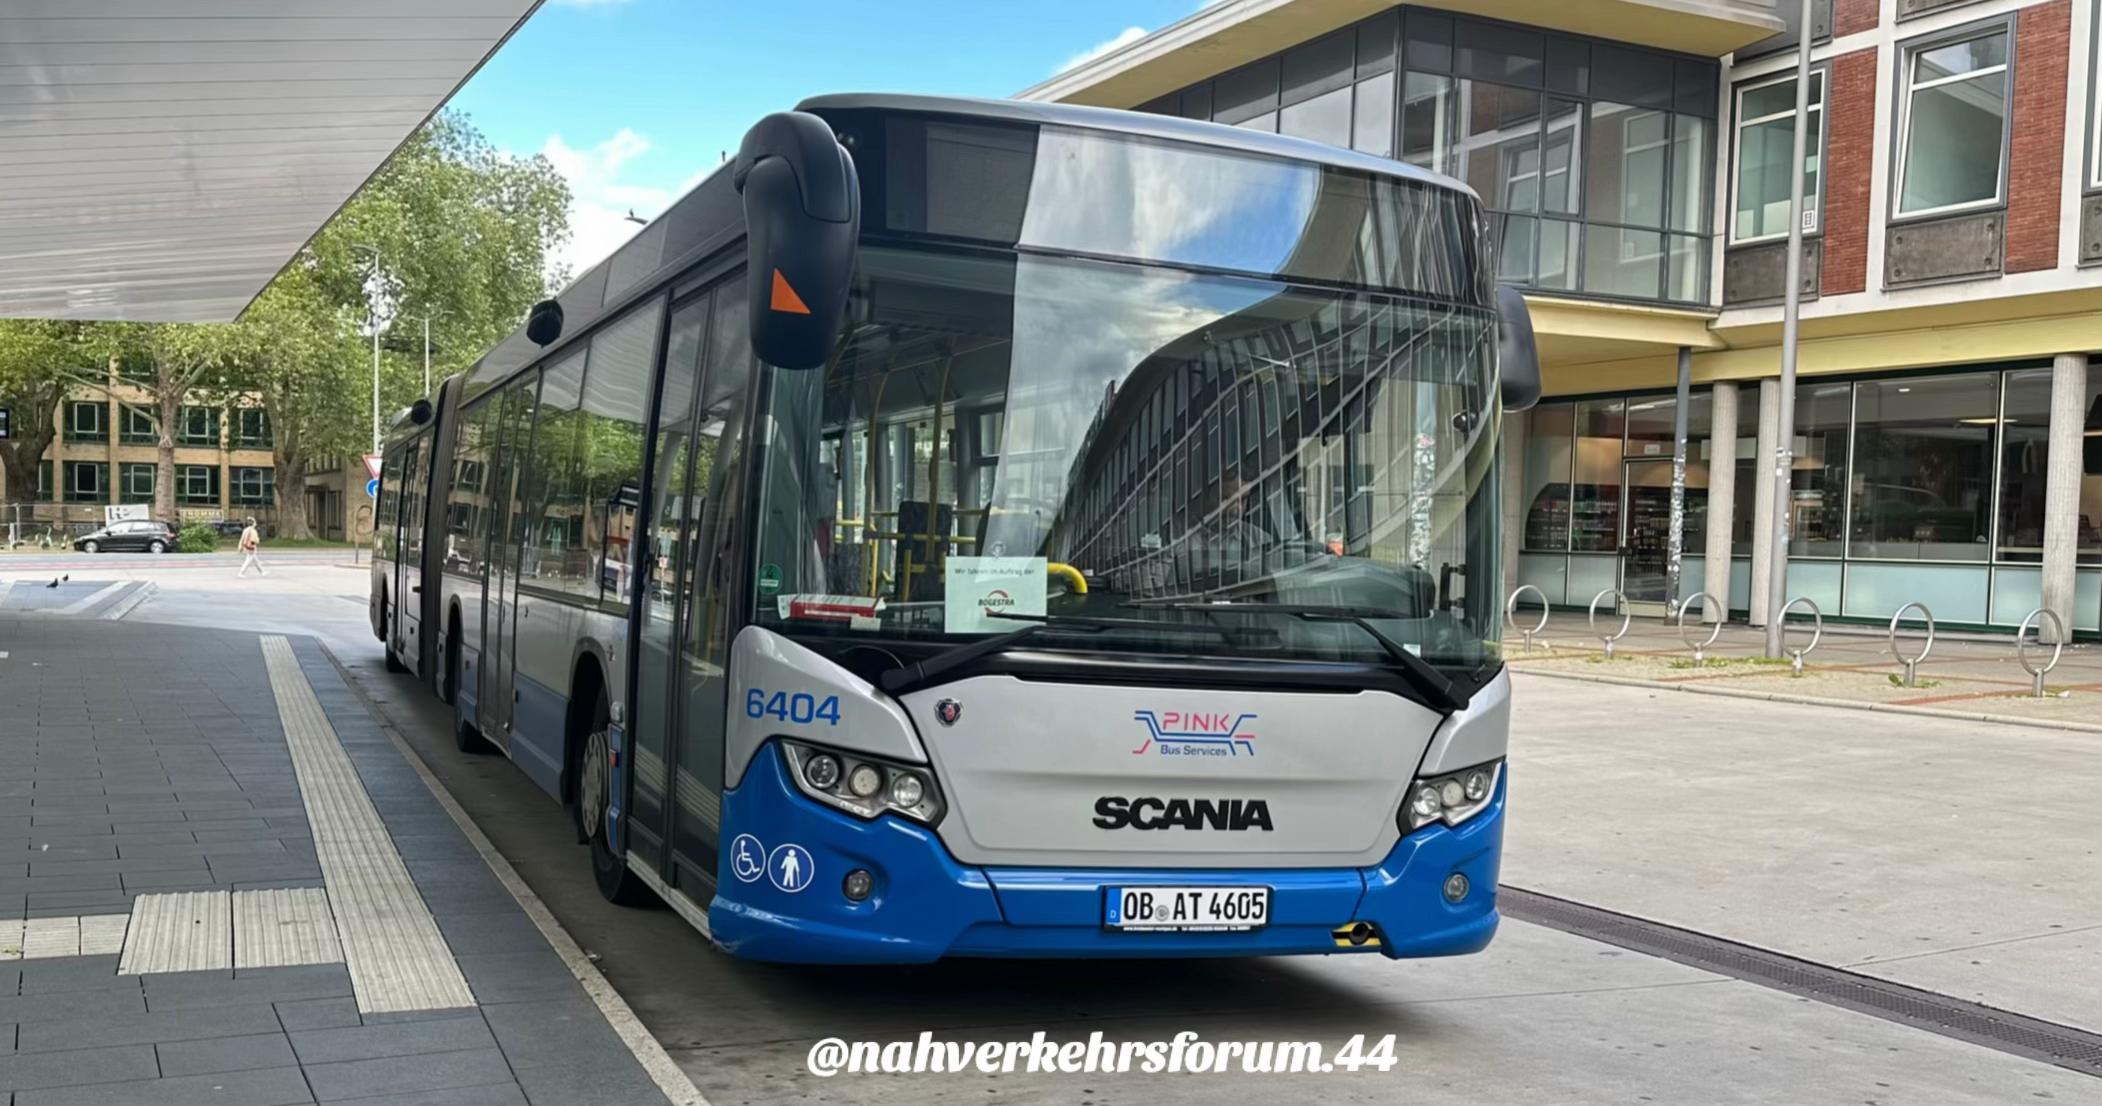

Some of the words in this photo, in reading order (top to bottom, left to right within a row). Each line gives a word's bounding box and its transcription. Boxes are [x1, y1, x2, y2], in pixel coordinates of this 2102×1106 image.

[977, 598, 1015, 607] BOGESTRA
[746, 688, 841, 726] 6404
[1162, 712, 1230, 732] PINK
[1160, 744, 1181, 756] Bus
[1183, 745, 1227, 757] Services
[1092, 796, 1274, 832] SCANIA
[1110, 910, 1117, 919] D
[1123, 892, 1154, 921] OB
[1173, 892, 1203, 921] AT
[1208, 892, 1265, 920] 4605
